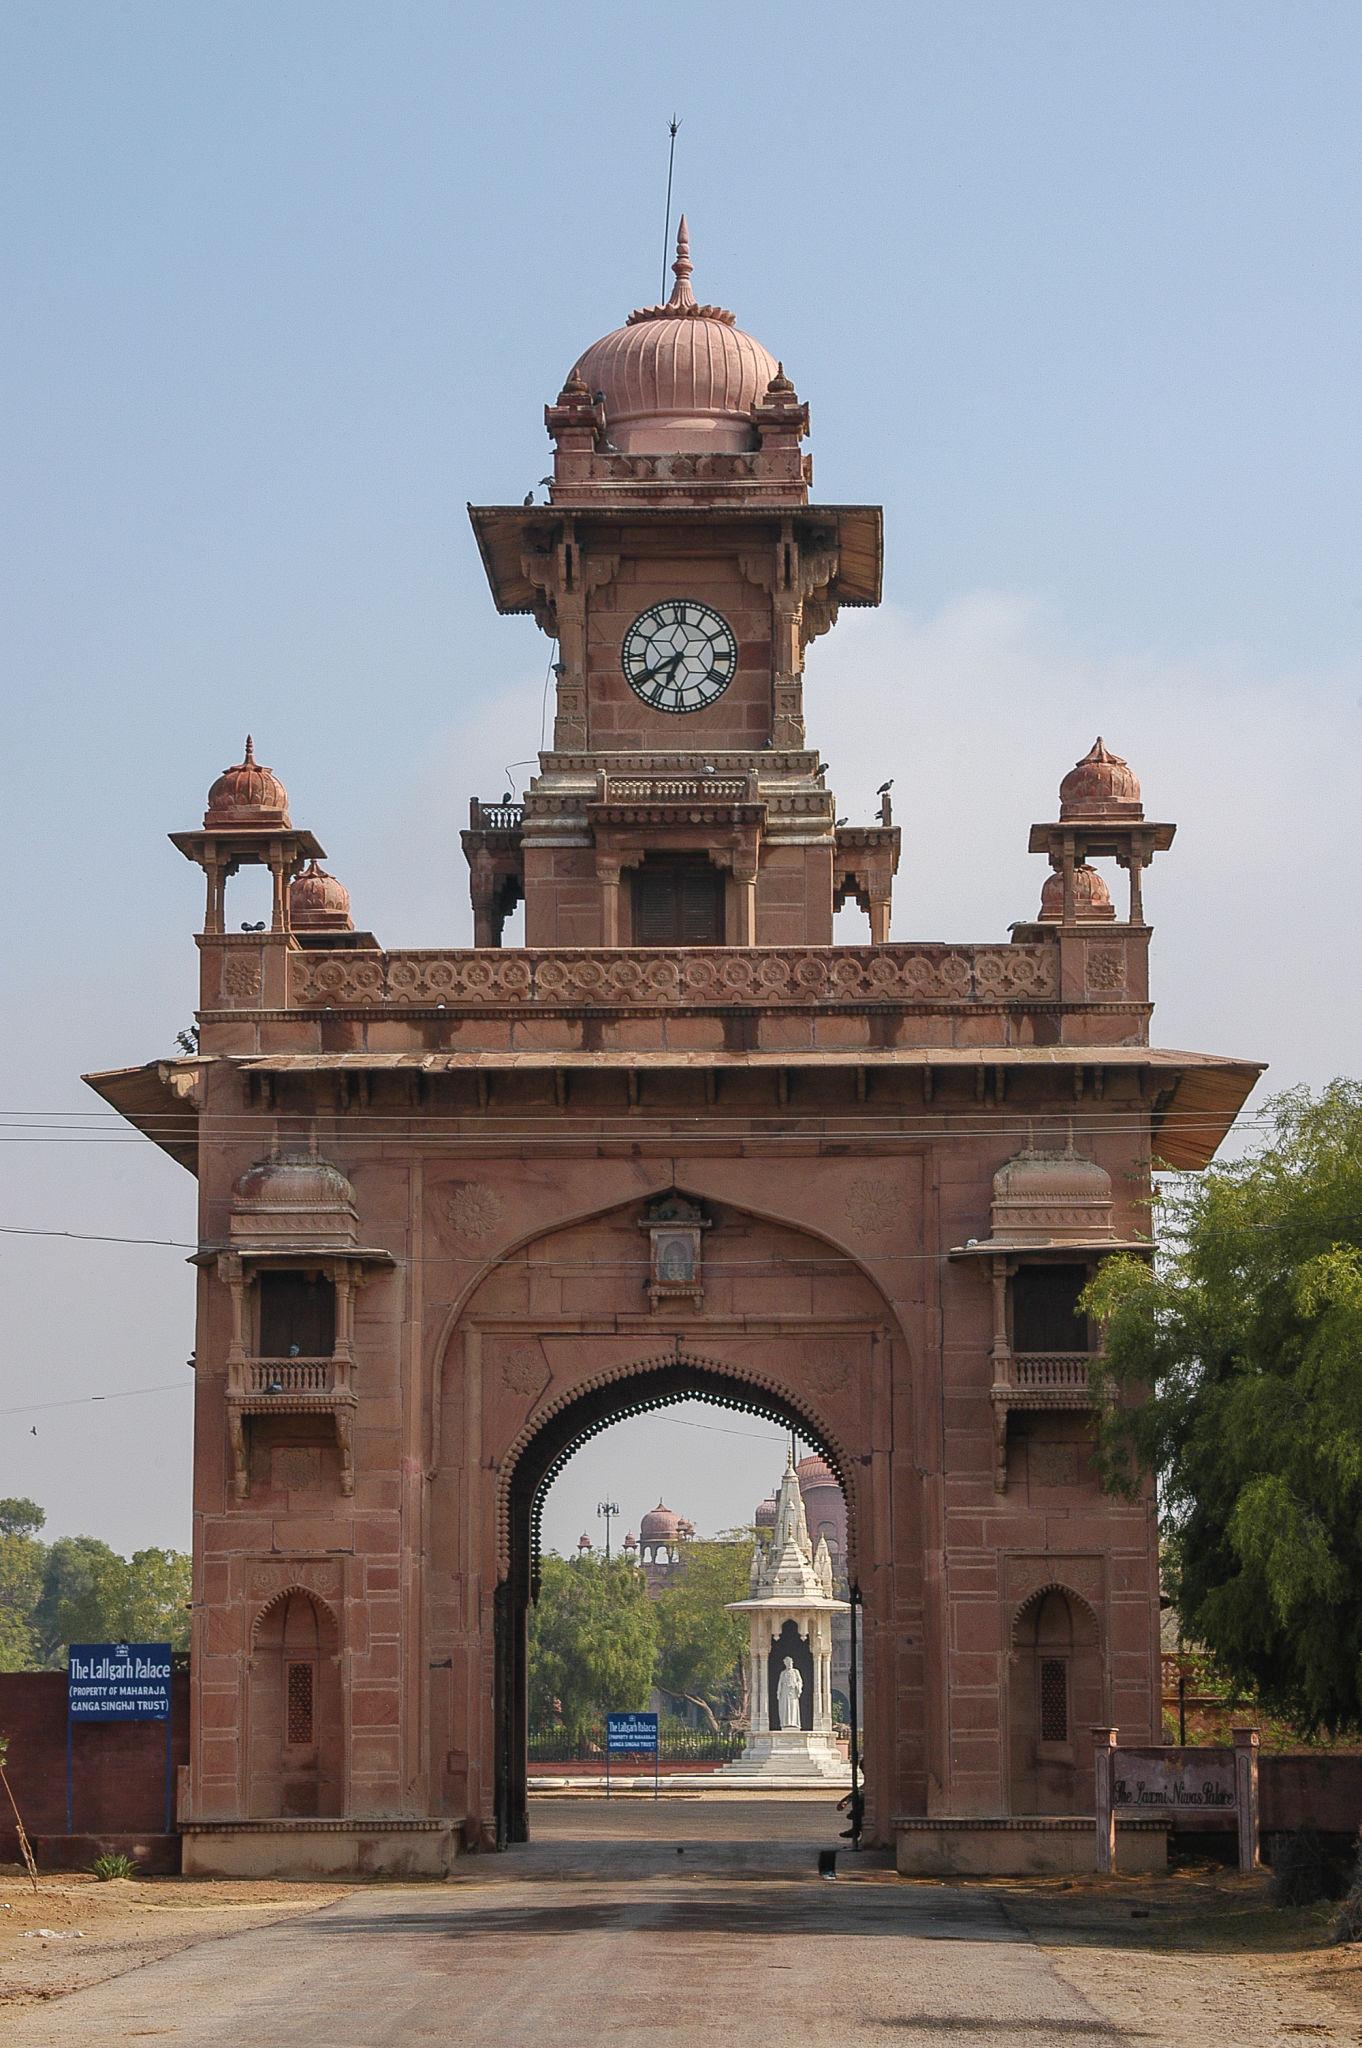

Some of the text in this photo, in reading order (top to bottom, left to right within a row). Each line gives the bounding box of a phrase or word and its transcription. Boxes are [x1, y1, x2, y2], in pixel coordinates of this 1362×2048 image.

[70, 1657, 171, 1680] The Lallgarh Palace
[69, 1686, 167, 1698] (PROPERTY OF MAHARAJA
[71, 1698, 169, 1712] GANGA SINGHJI TRUST)
[609, 1721, 617, 1732] The
[638, 1721, 656, 1732] Palace
[1113, 1780, 1234, 1805] The Laxmi Niwas Palace
